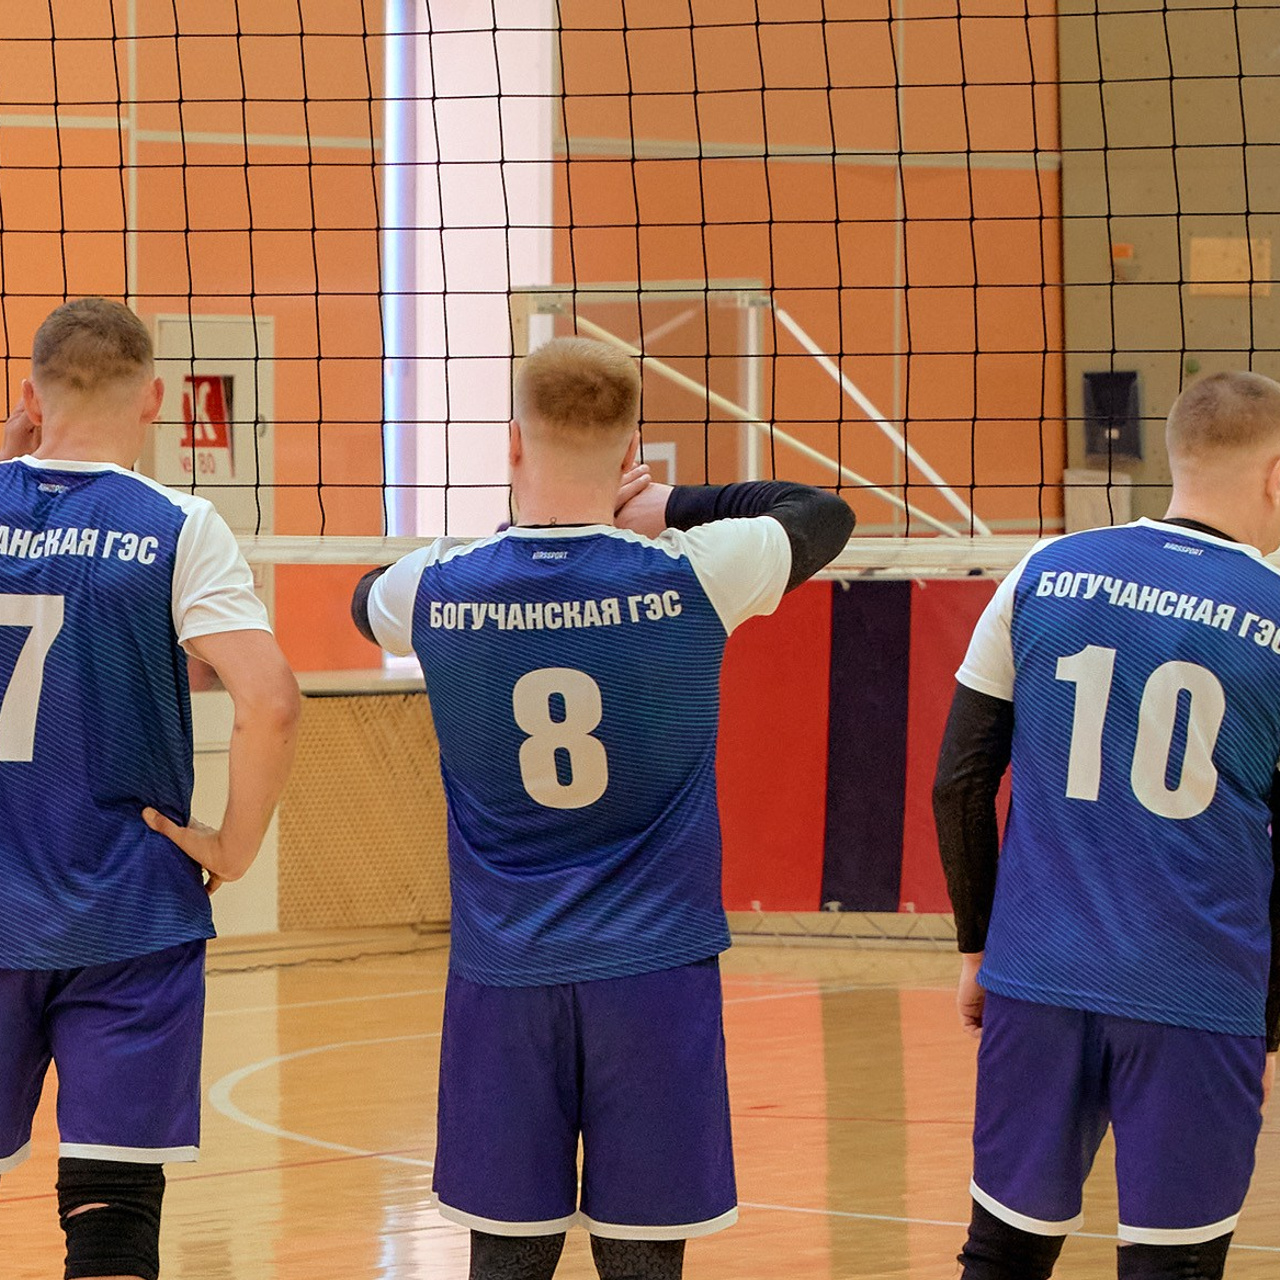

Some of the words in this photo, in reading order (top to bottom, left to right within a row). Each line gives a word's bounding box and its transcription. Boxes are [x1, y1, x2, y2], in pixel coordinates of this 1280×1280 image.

[102, 530, 159, 565] ГЭС
[429, 597, 621, 631] БОГУЧАНСКАЯ
[627, 590, 682, 623] ГЭС
[1036, 571, 1237, 632] БОГУЧАНСКАЯ
[512, 667, 609, 810] 8
[1055, 644, 1226, 820] 10
